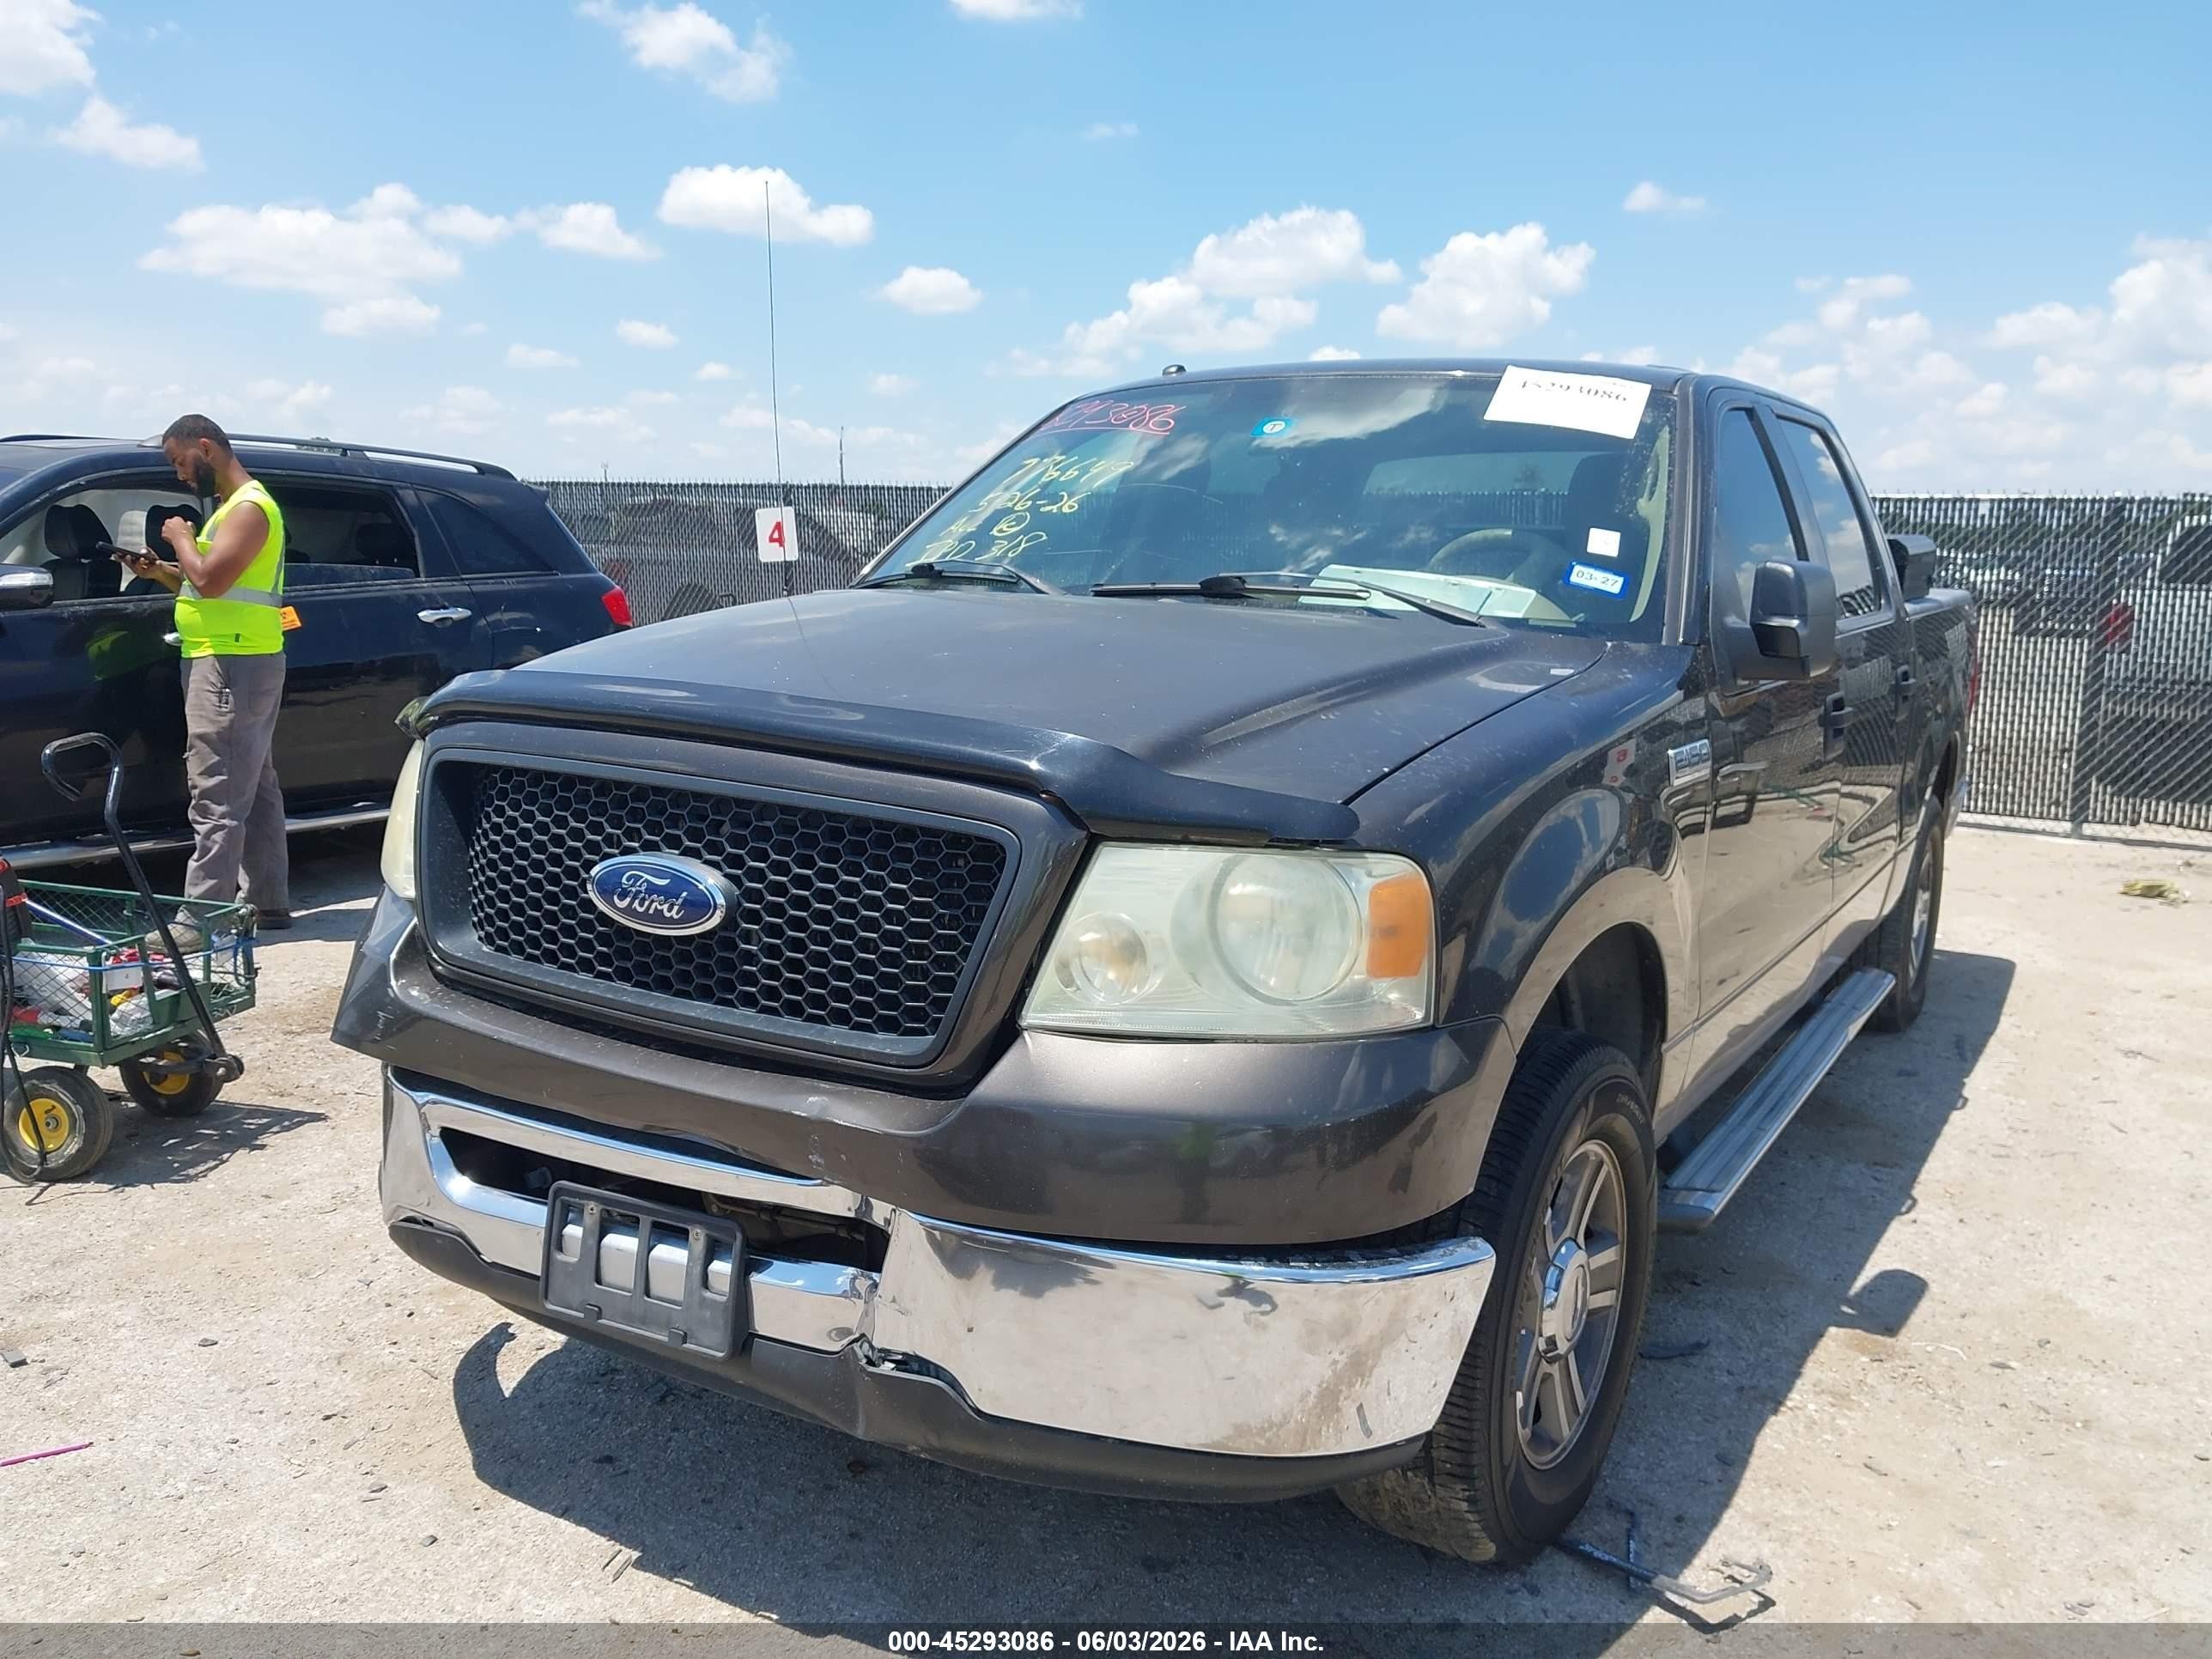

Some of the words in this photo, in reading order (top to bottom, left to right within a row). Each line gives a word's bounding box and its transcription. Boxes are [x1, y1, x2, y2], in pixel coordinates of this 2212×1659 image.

[769, 521, 785, 547] 4
[975, 532, 1048, 561] 318
[1577, 570, 1619, 586] 03-27
[613, 871, 688, 920] Ford
